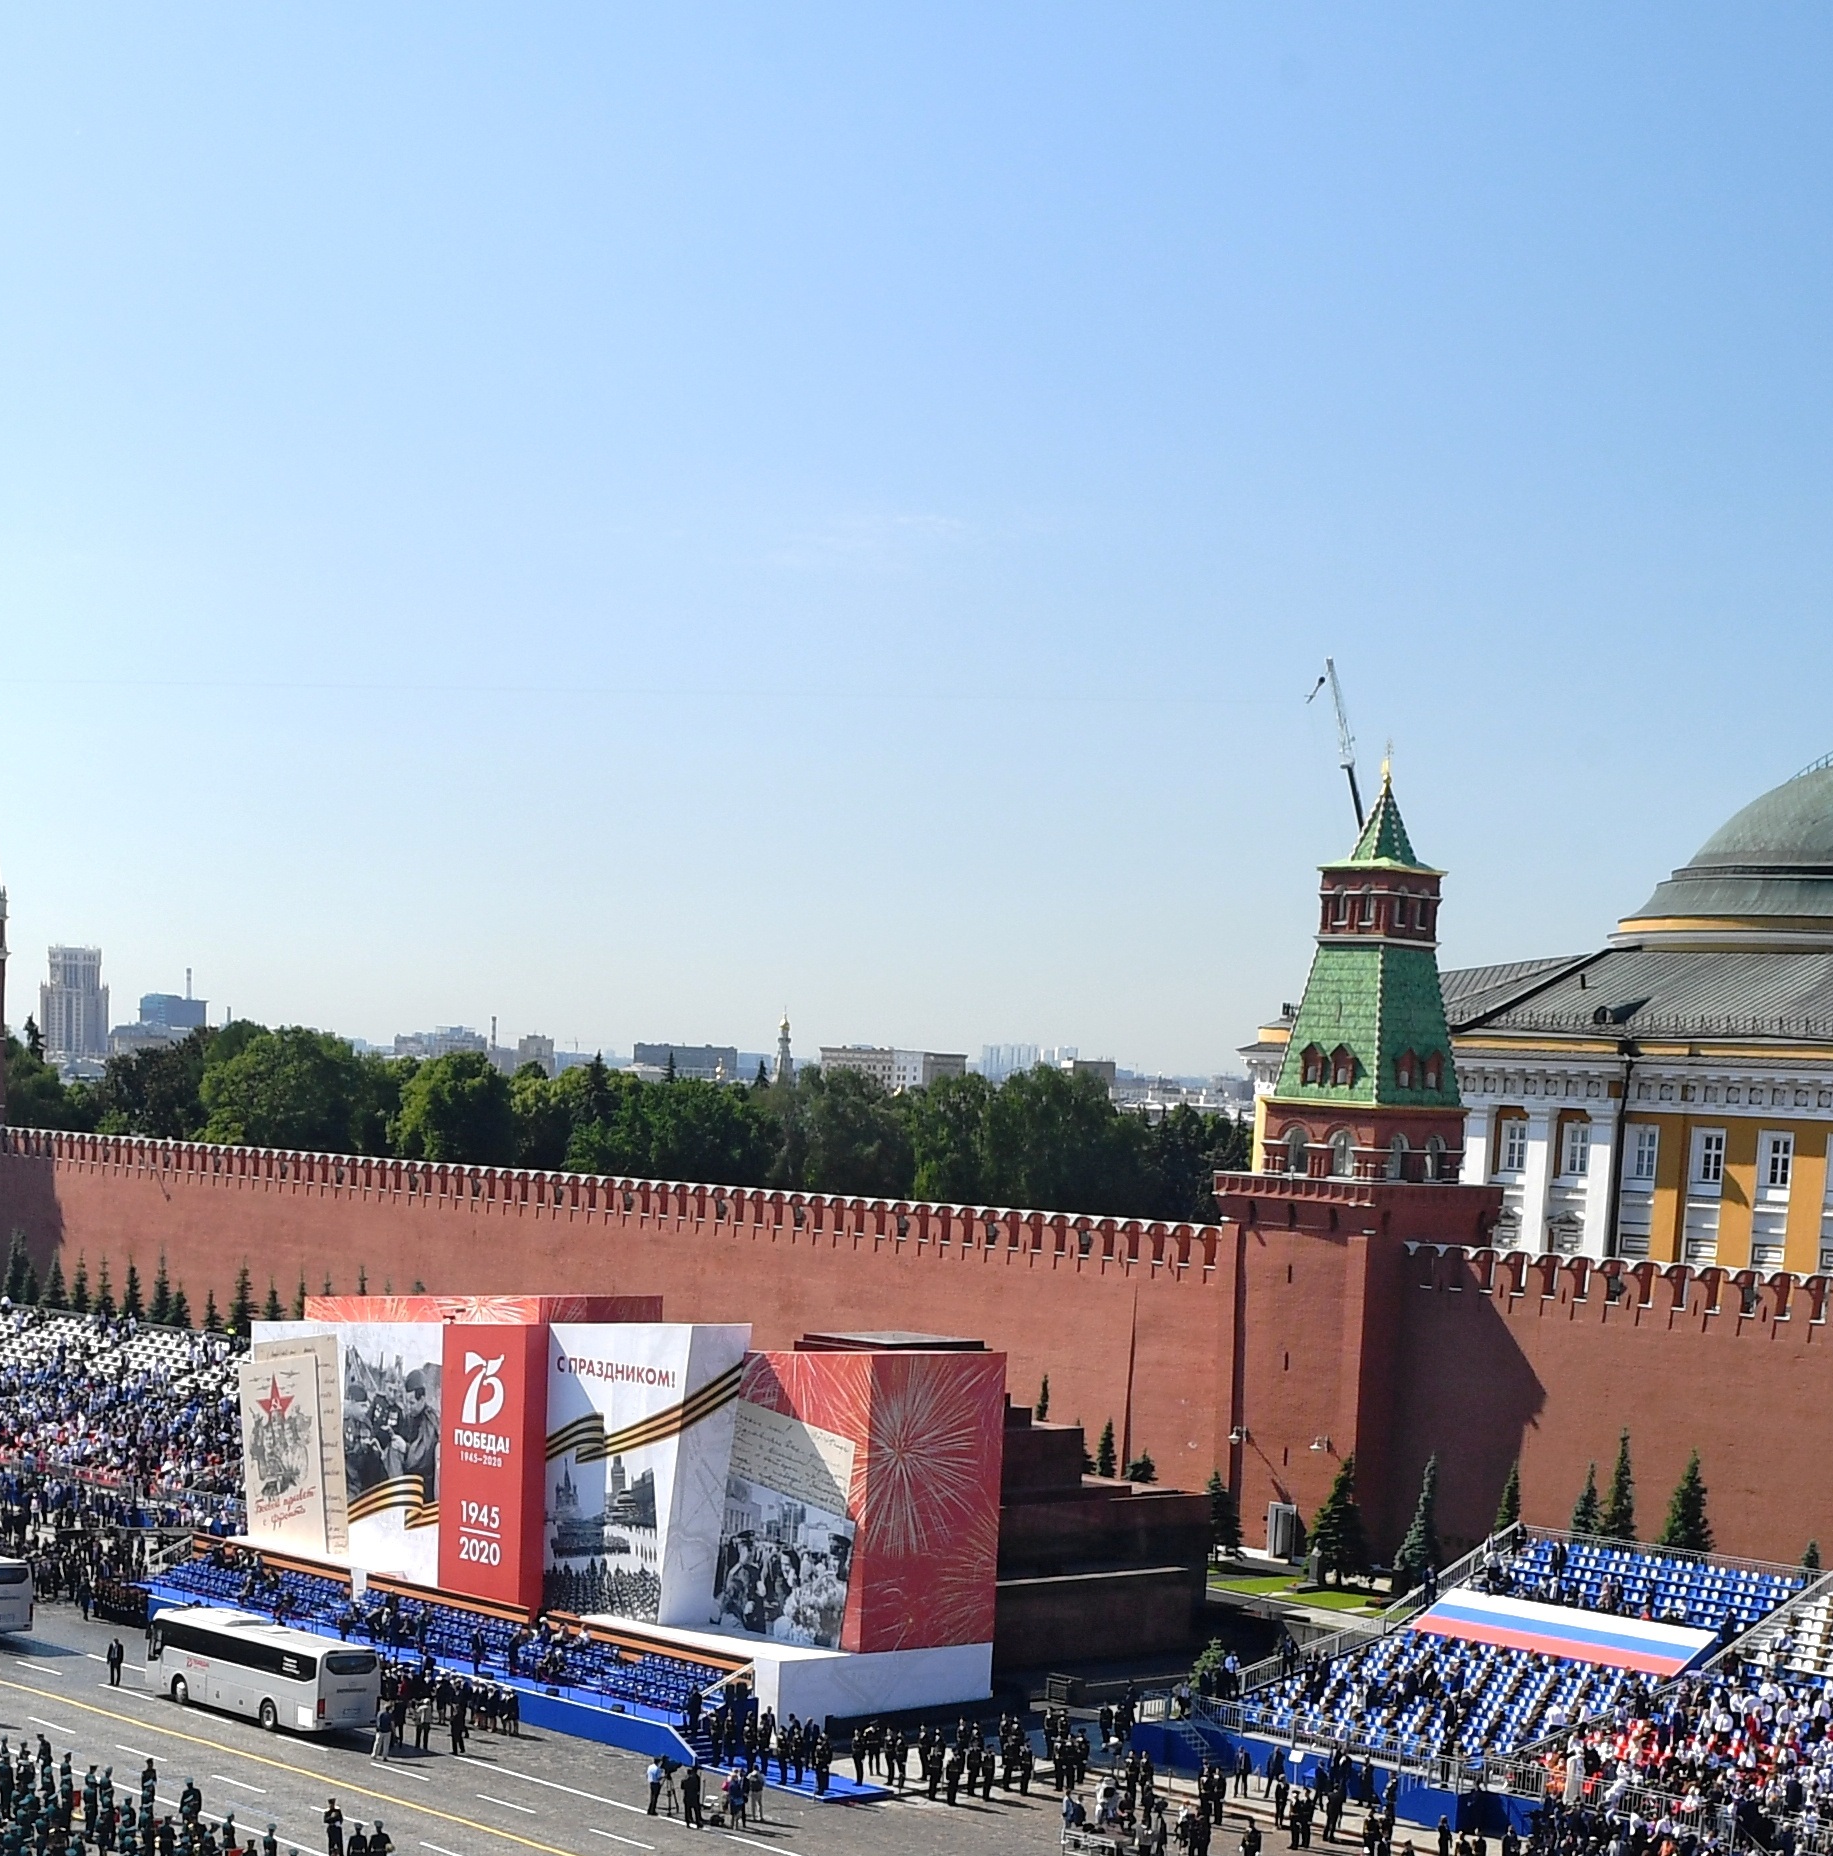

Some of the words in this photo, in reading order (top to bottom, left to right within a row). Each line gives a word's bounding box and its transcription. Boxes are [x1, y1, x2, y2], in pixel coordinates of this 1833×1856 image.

[556, 1356, 565, 1373] С
[568, 1357, 676, 1388] ПРАЗДНИКОМ!
[461, 1351, 505, 1425] 75
[454, 1428, 510, 1455] ПОБЕДА!
[461, 1500, 500, 1529] 1945
[459, 1536, 501, 1566] 2020
